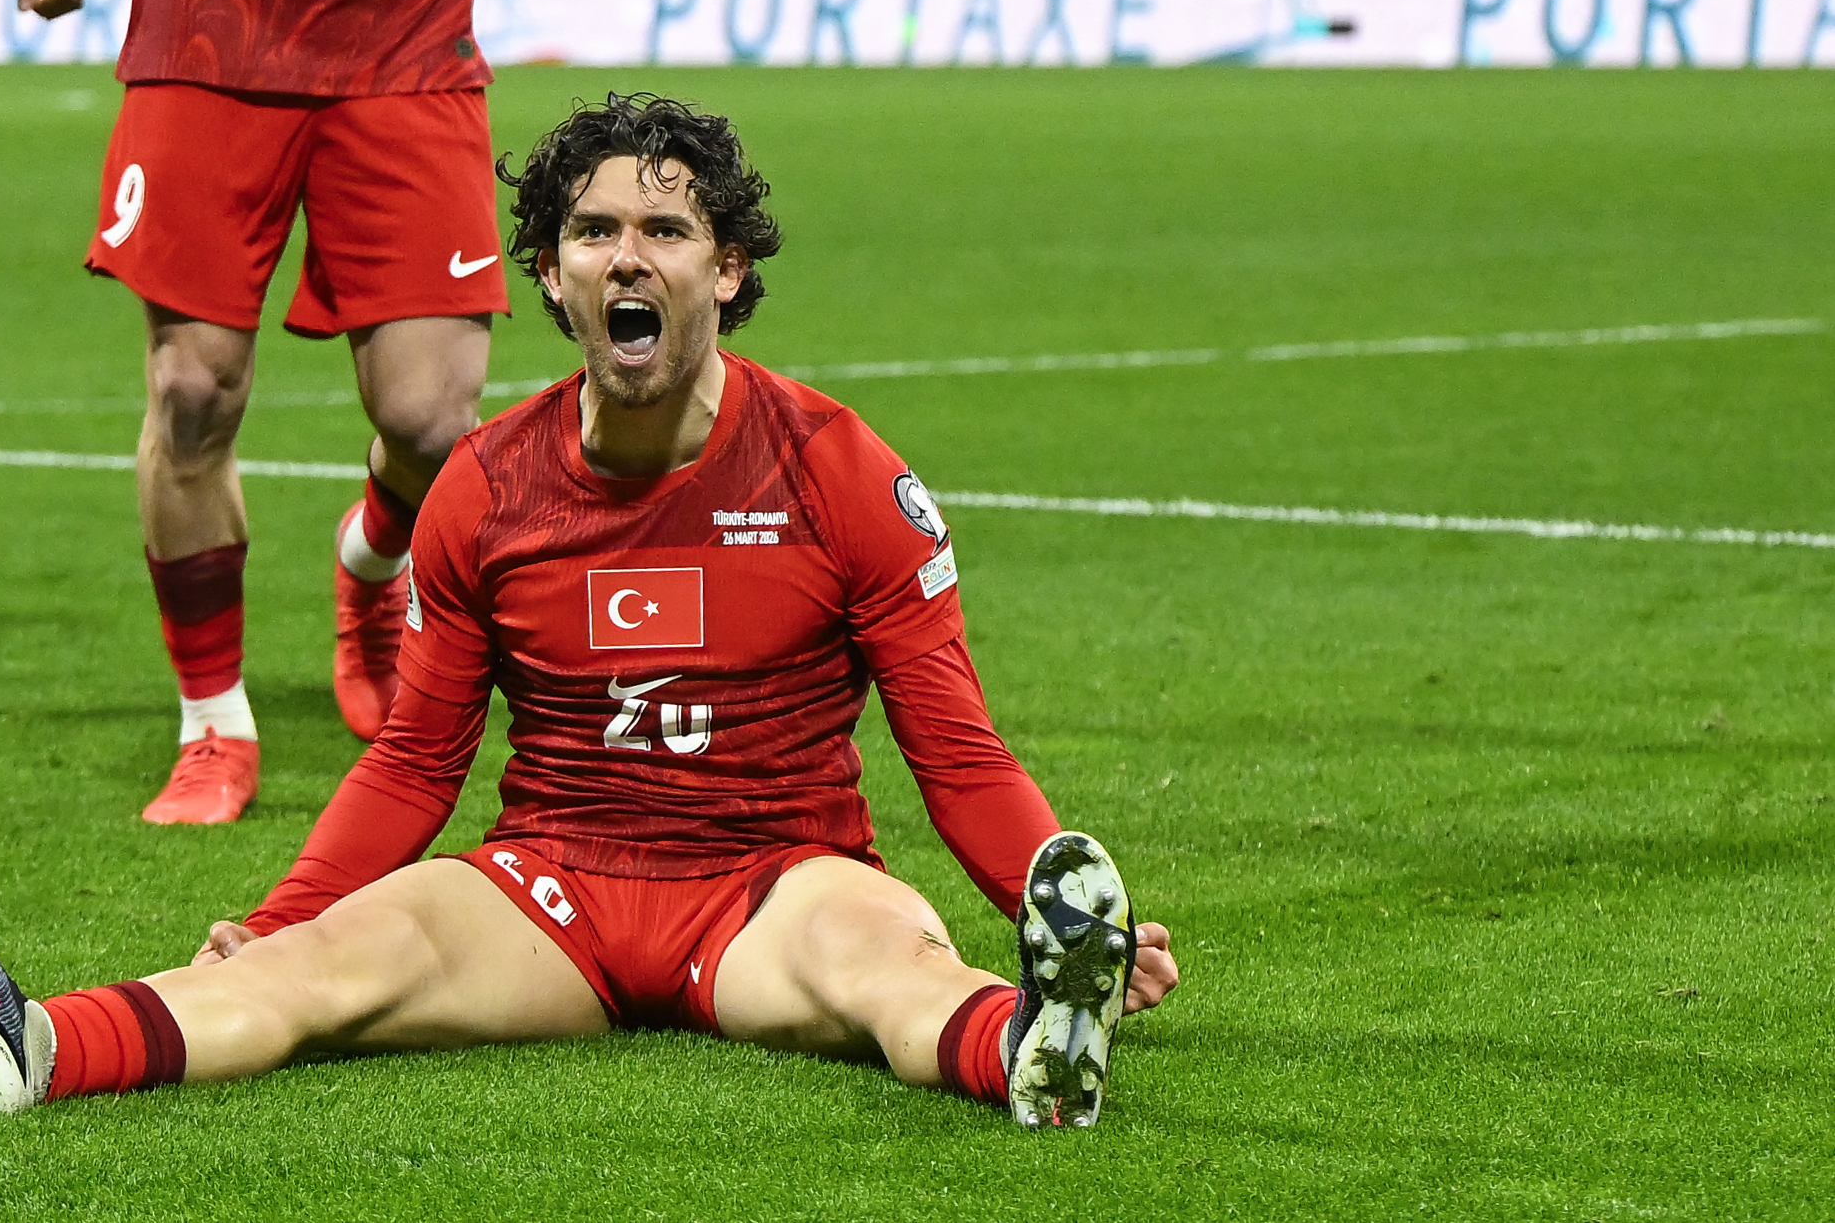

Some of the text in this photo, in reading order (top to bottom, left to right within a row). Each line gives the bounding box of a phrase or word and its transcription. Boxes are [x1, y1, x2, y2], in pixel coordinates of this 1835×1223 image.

[101, 163, 146, 249] 9
[712, 510, 789, 526] TÜRKİYE-ROMANYA
[722, 531, 779, 545] 26 MART 2026
